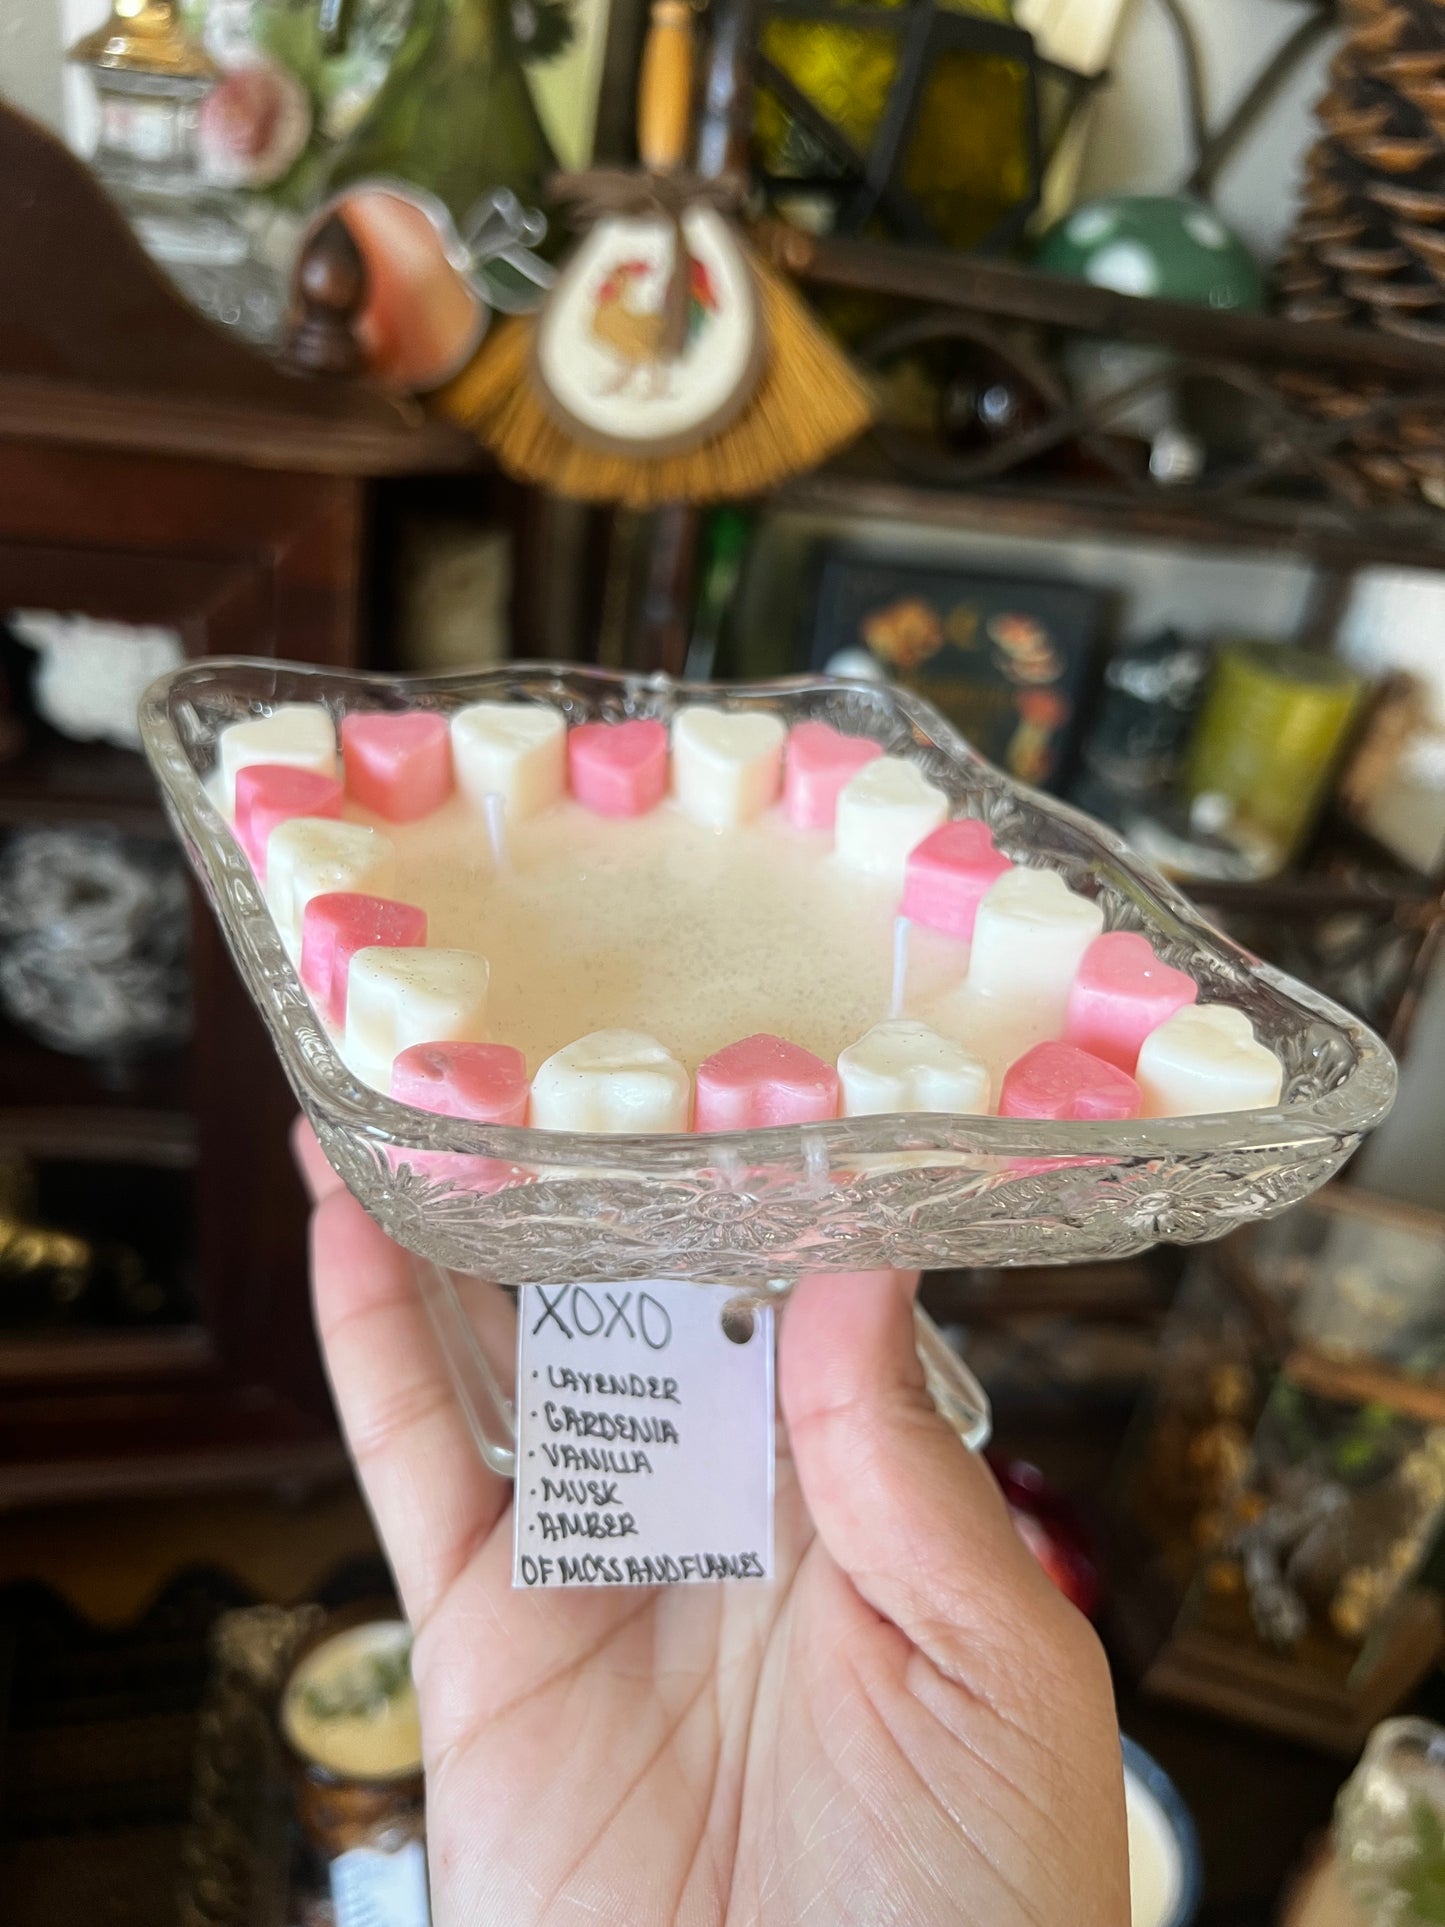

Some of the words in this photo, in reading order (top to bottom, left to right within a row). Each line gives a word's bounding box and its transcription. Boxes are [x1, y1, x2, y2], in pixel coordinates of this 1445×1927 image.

[532, 1284, 673, 1350] XOXO
[547, 1364, 682, 1404] LAVENDER
[543, 1400, 680, 1445] GARDENIA
[541, 1442, 654, 1475] VANILLA
[541, 1477, 624, 1506] MUSK
[537, 1511, 640, 1542] AMBER
